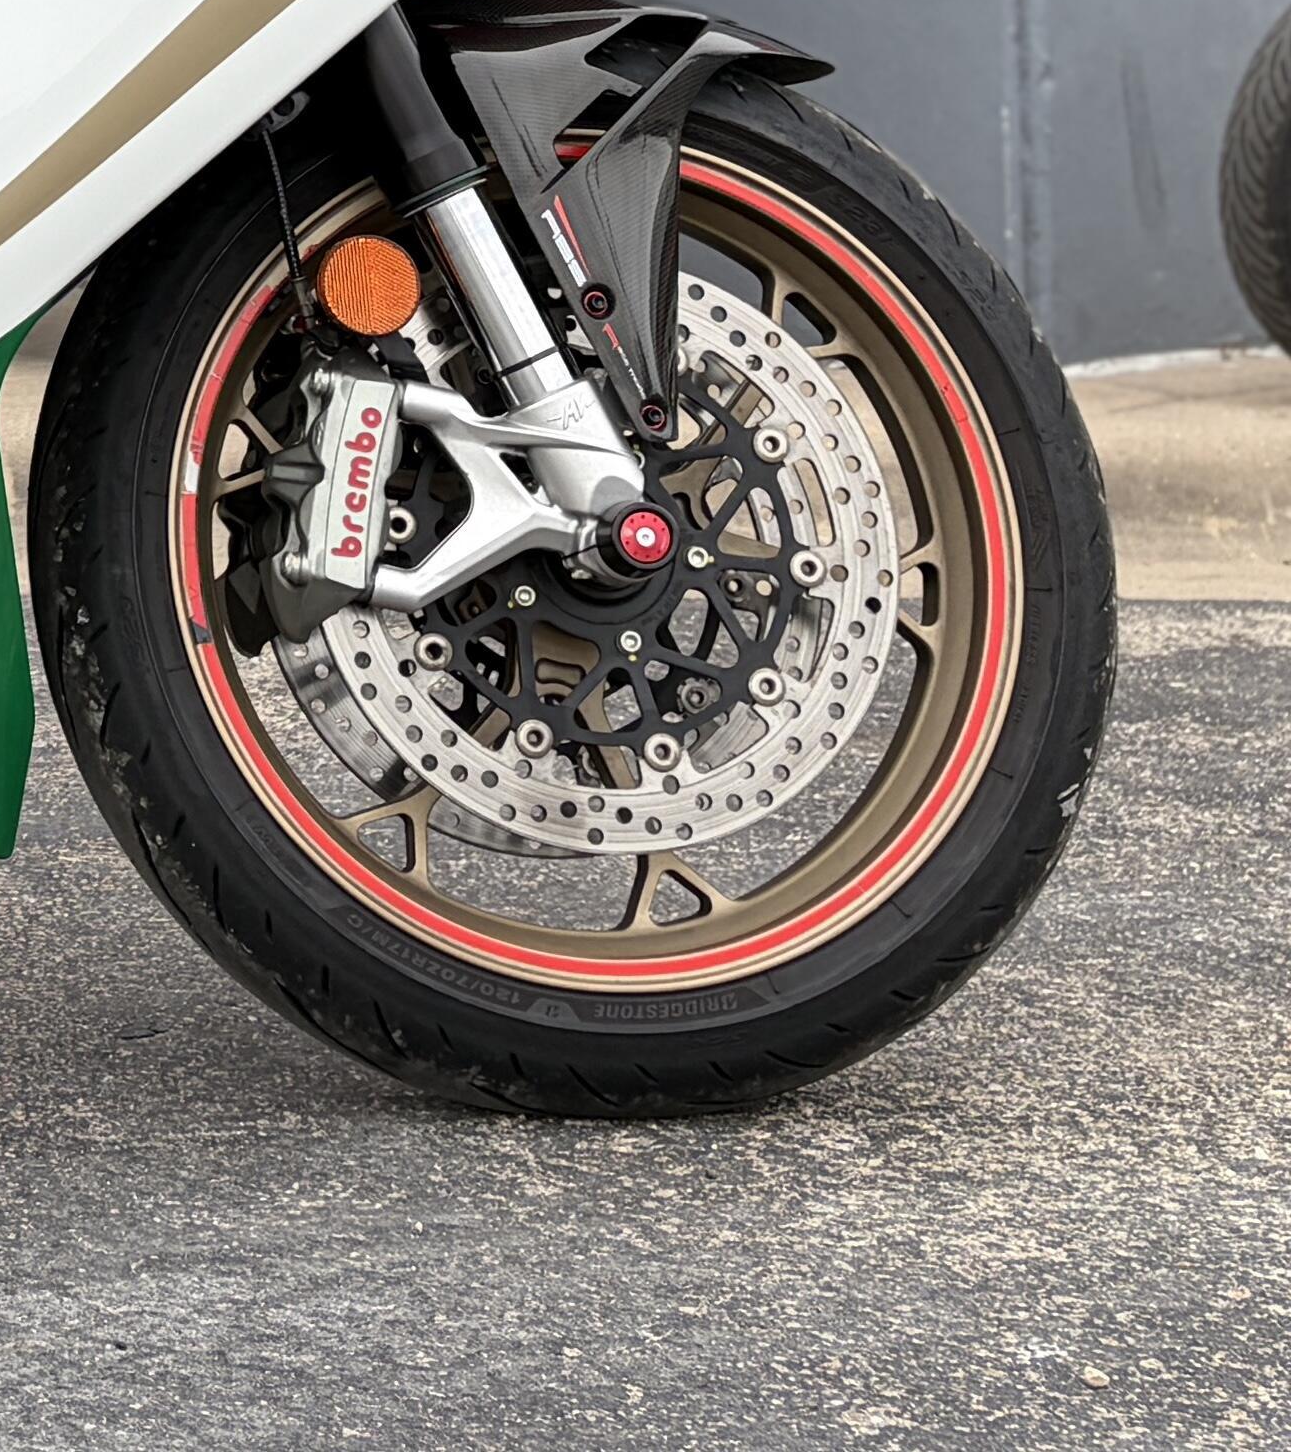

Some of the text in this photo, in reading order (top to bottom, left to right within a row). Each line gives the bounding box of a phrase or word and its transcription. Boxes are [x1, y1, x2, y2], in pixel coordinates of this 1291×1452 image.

[330, 406, 383, 558] brembo
[346, 913, 520, 1005] 120/70ZR17M/C
[593, 991, 739, 1020] BRIDGESTONE
